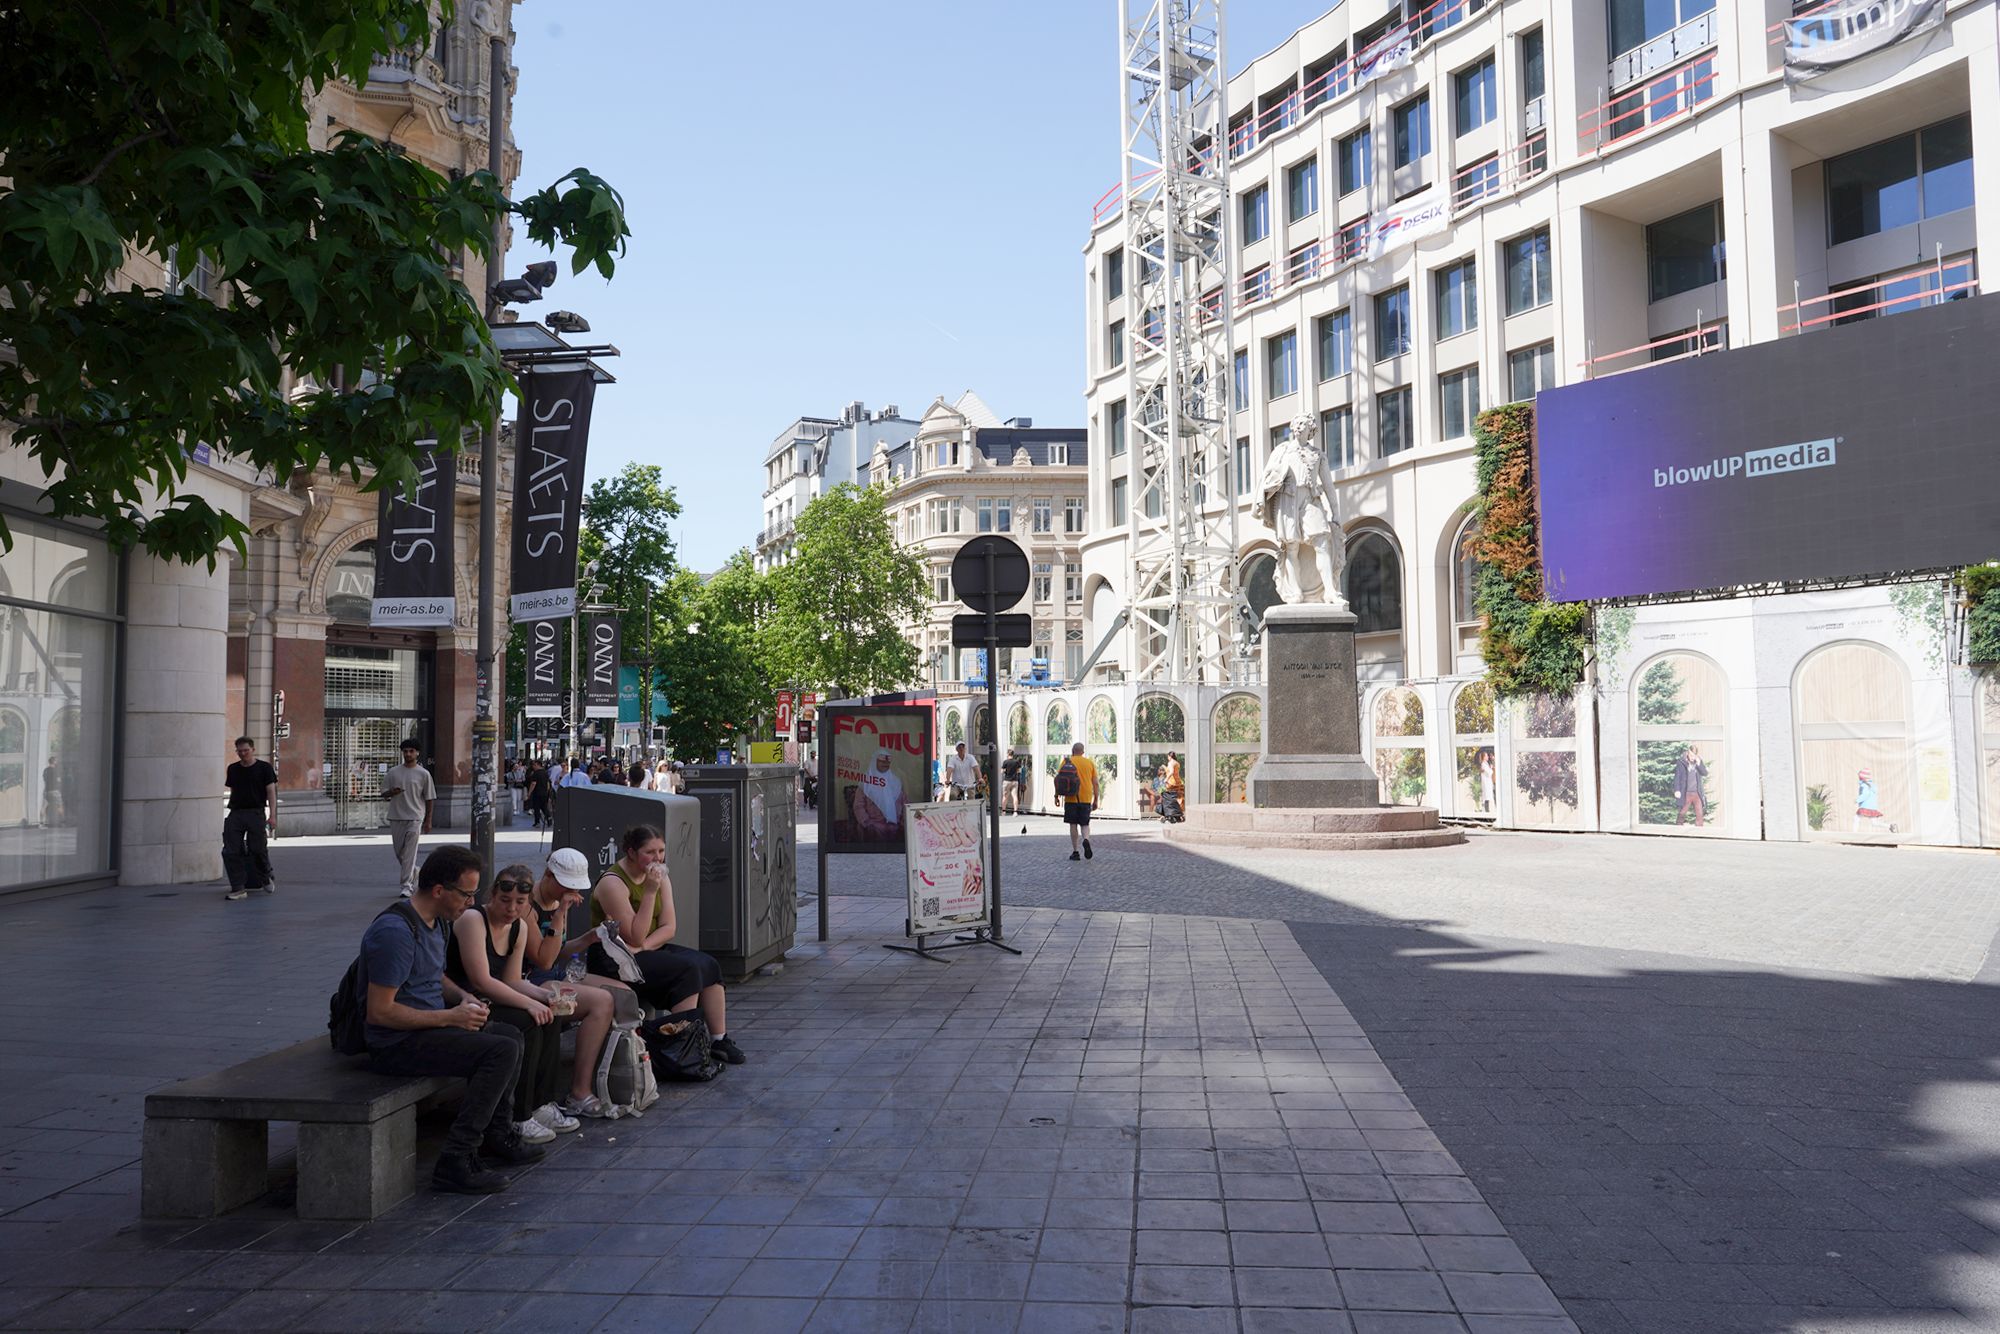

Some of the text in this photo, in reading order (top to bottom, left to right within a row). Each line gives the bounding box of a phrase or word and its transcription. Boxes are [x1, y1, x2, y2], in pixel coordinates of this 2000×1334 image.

[525, 398, 574, 558] SLAETS
[378, 602, 445, 616] meir-as.be
[518, 594, 569, 611] meir-as.be
[534, 621, 555, 685] INNO
[593, 623, 614, 686] INNO
[836, 768, 887, 787] FAMILIES
